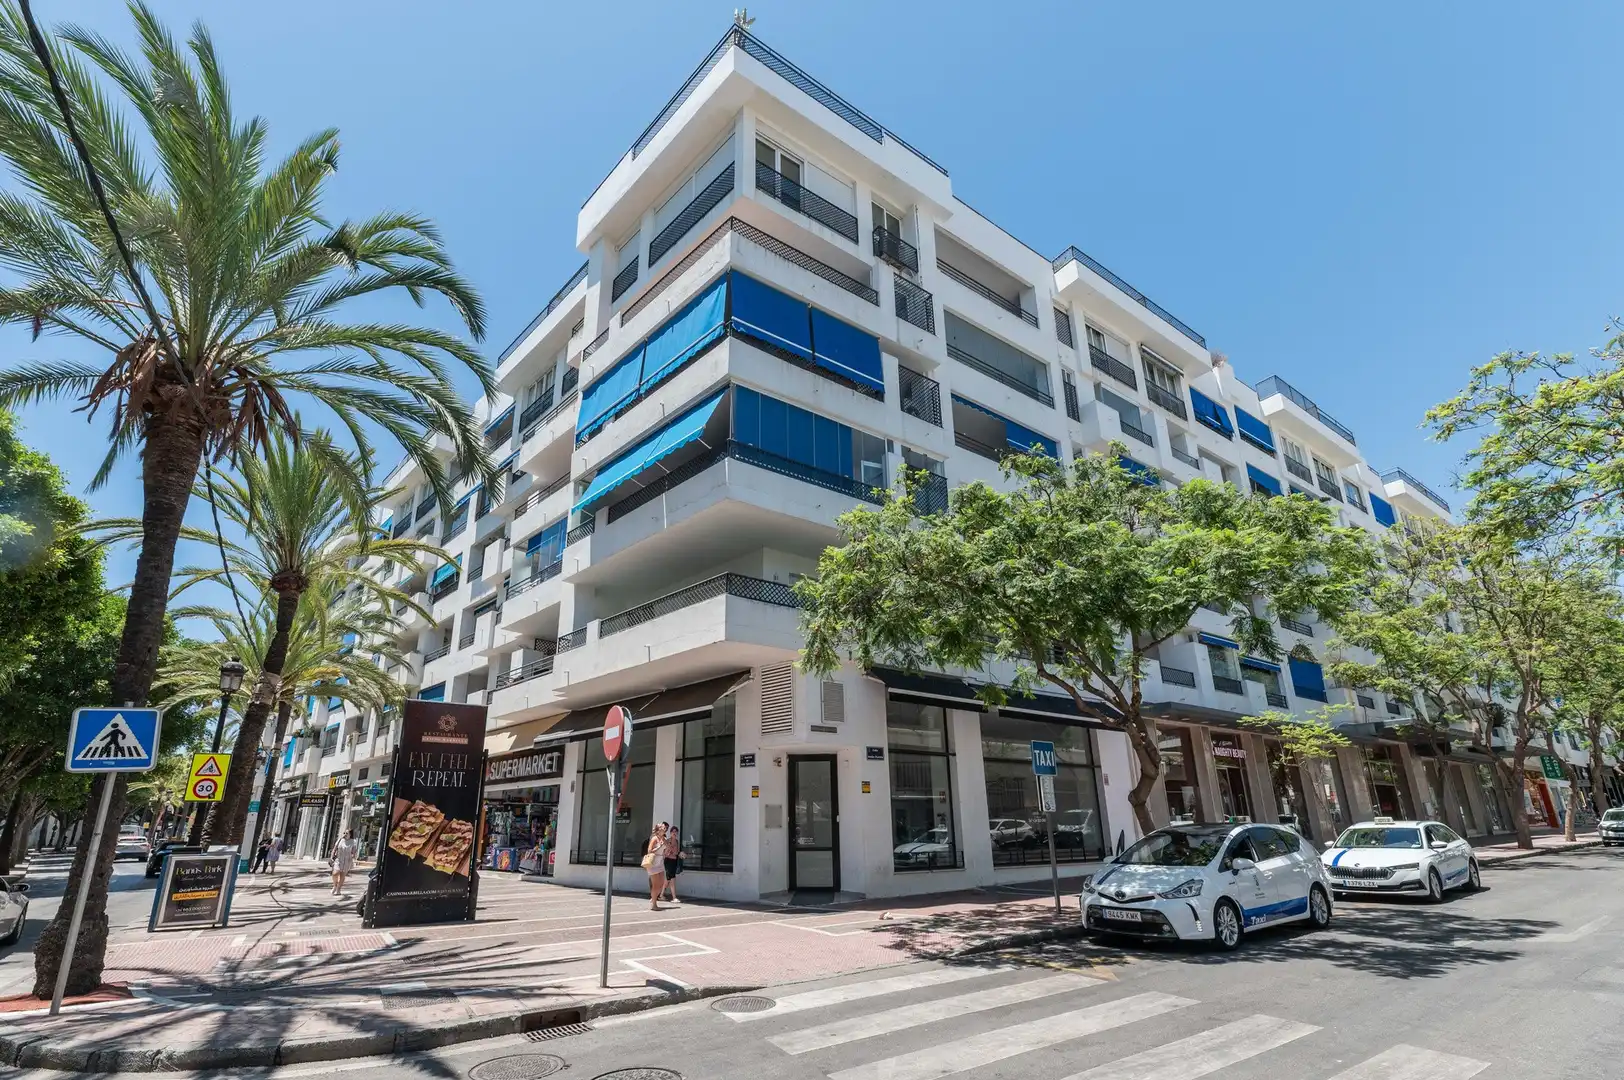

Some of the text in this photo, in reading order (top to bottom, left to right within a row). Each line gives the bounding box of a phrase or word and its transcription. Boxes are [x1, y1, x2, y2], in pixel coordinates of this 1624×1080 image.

[1034, 750, 1055, 766] TAXI
[490, 752, 560, 780] SUPERMARKET
[412, 769, 467, 788] REPEAT.
[198, 784, 213, 793] 30
[1107, 910, 1125, 919] 9445
[1251, 914, 1267, 925] Taxi
